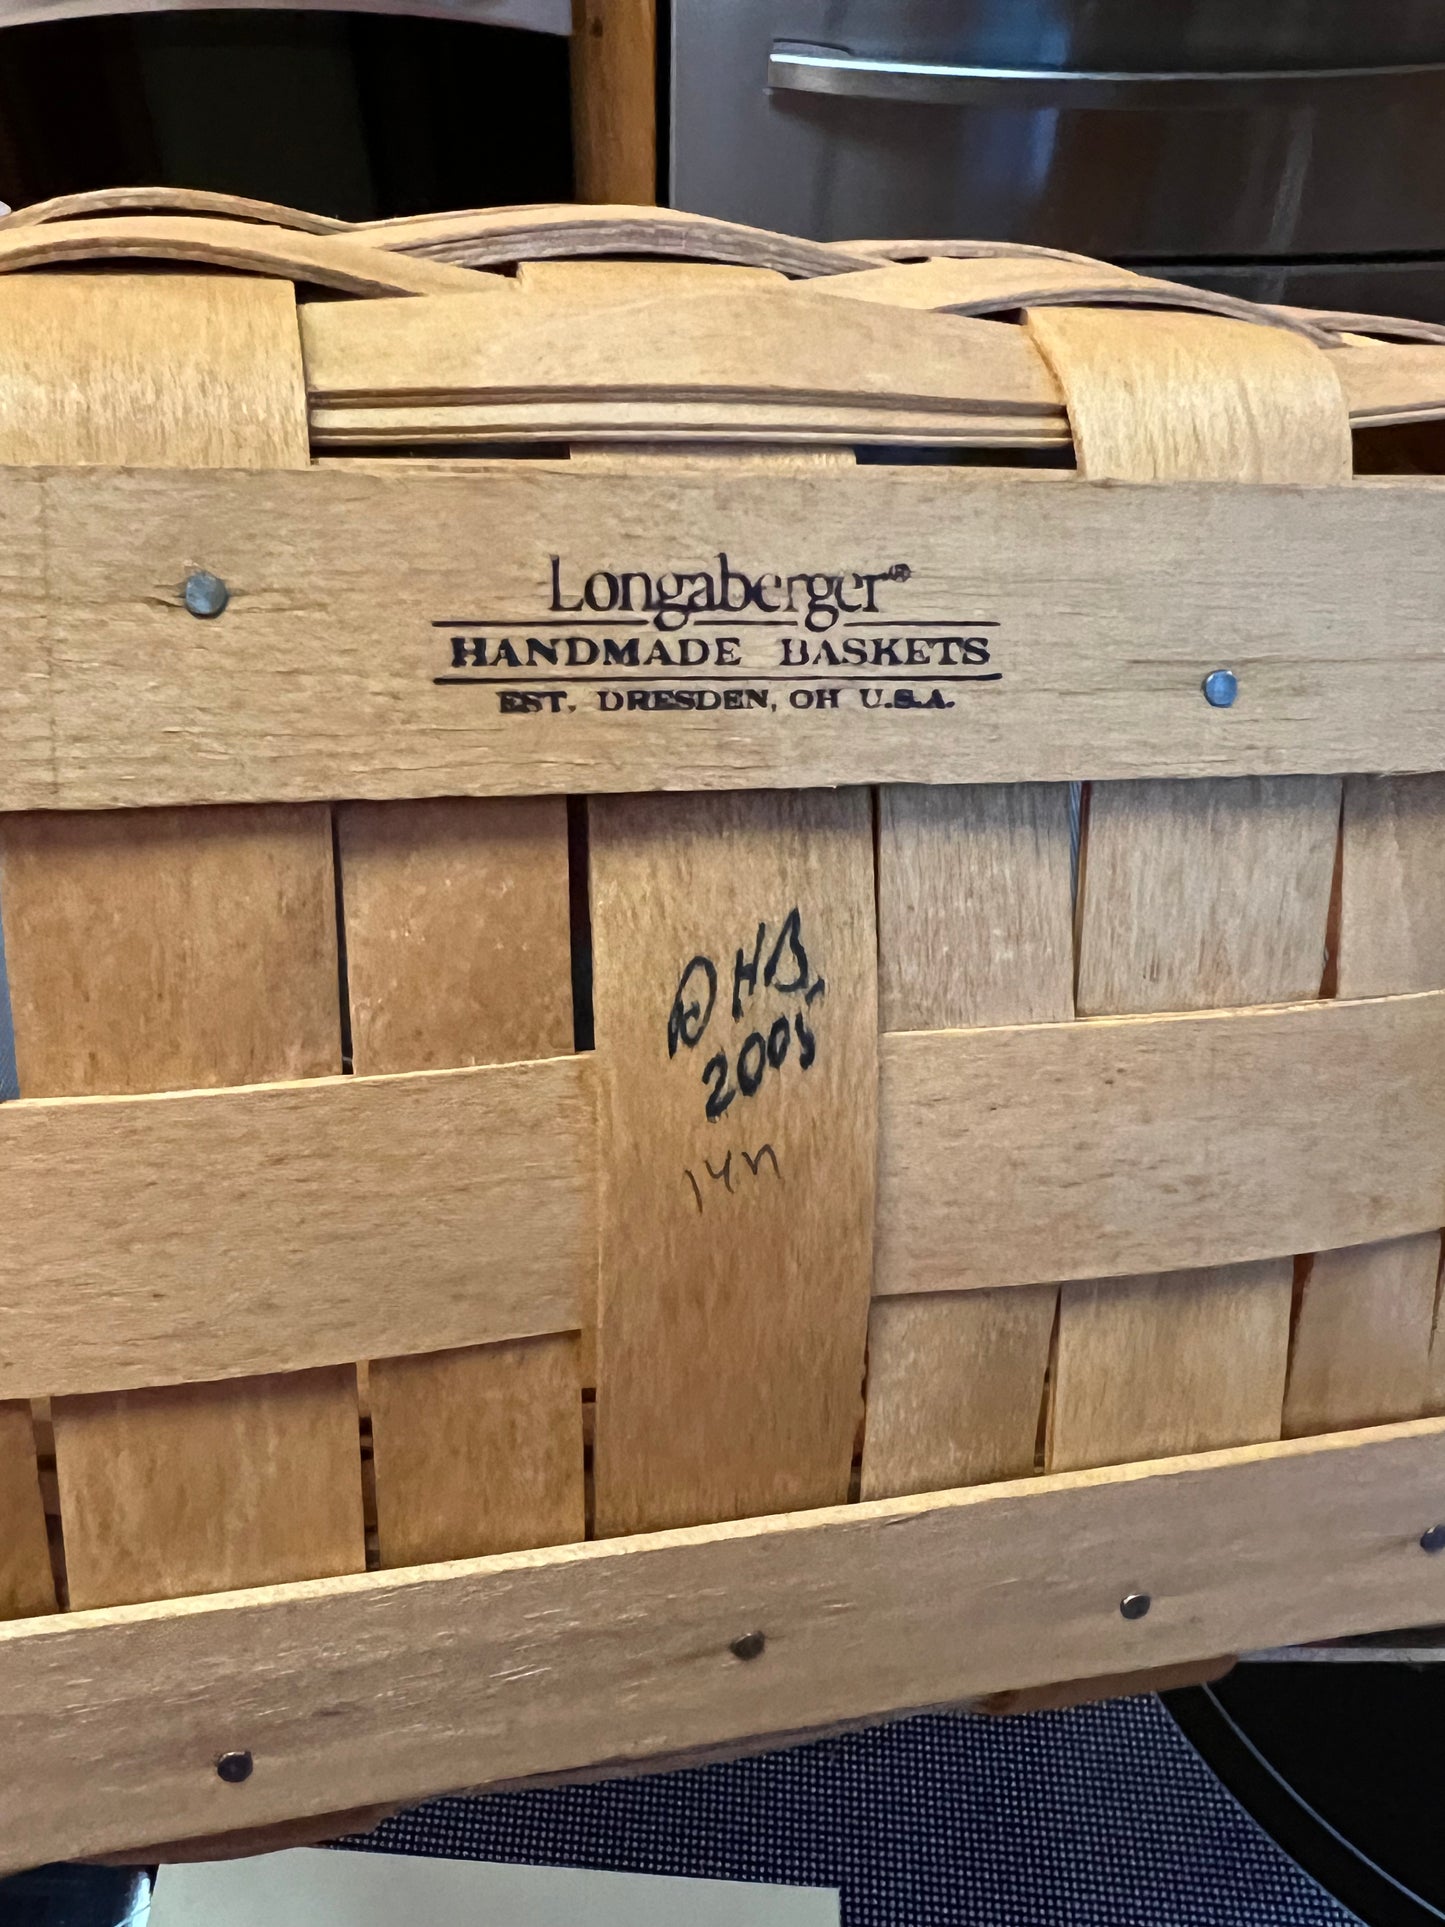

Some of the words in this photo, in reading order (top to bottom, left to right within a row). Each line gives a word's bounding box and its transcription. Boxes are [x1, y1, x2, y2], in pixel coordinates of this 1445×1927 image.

[449, 636, 742, 667] HANDMADE
[779, 636, 991, 666] BASKETS
[498, 690, 577, 713] EST.
[599, 689, 777, 712] DRESDEN,
[788, 689, 839, 710] OH
